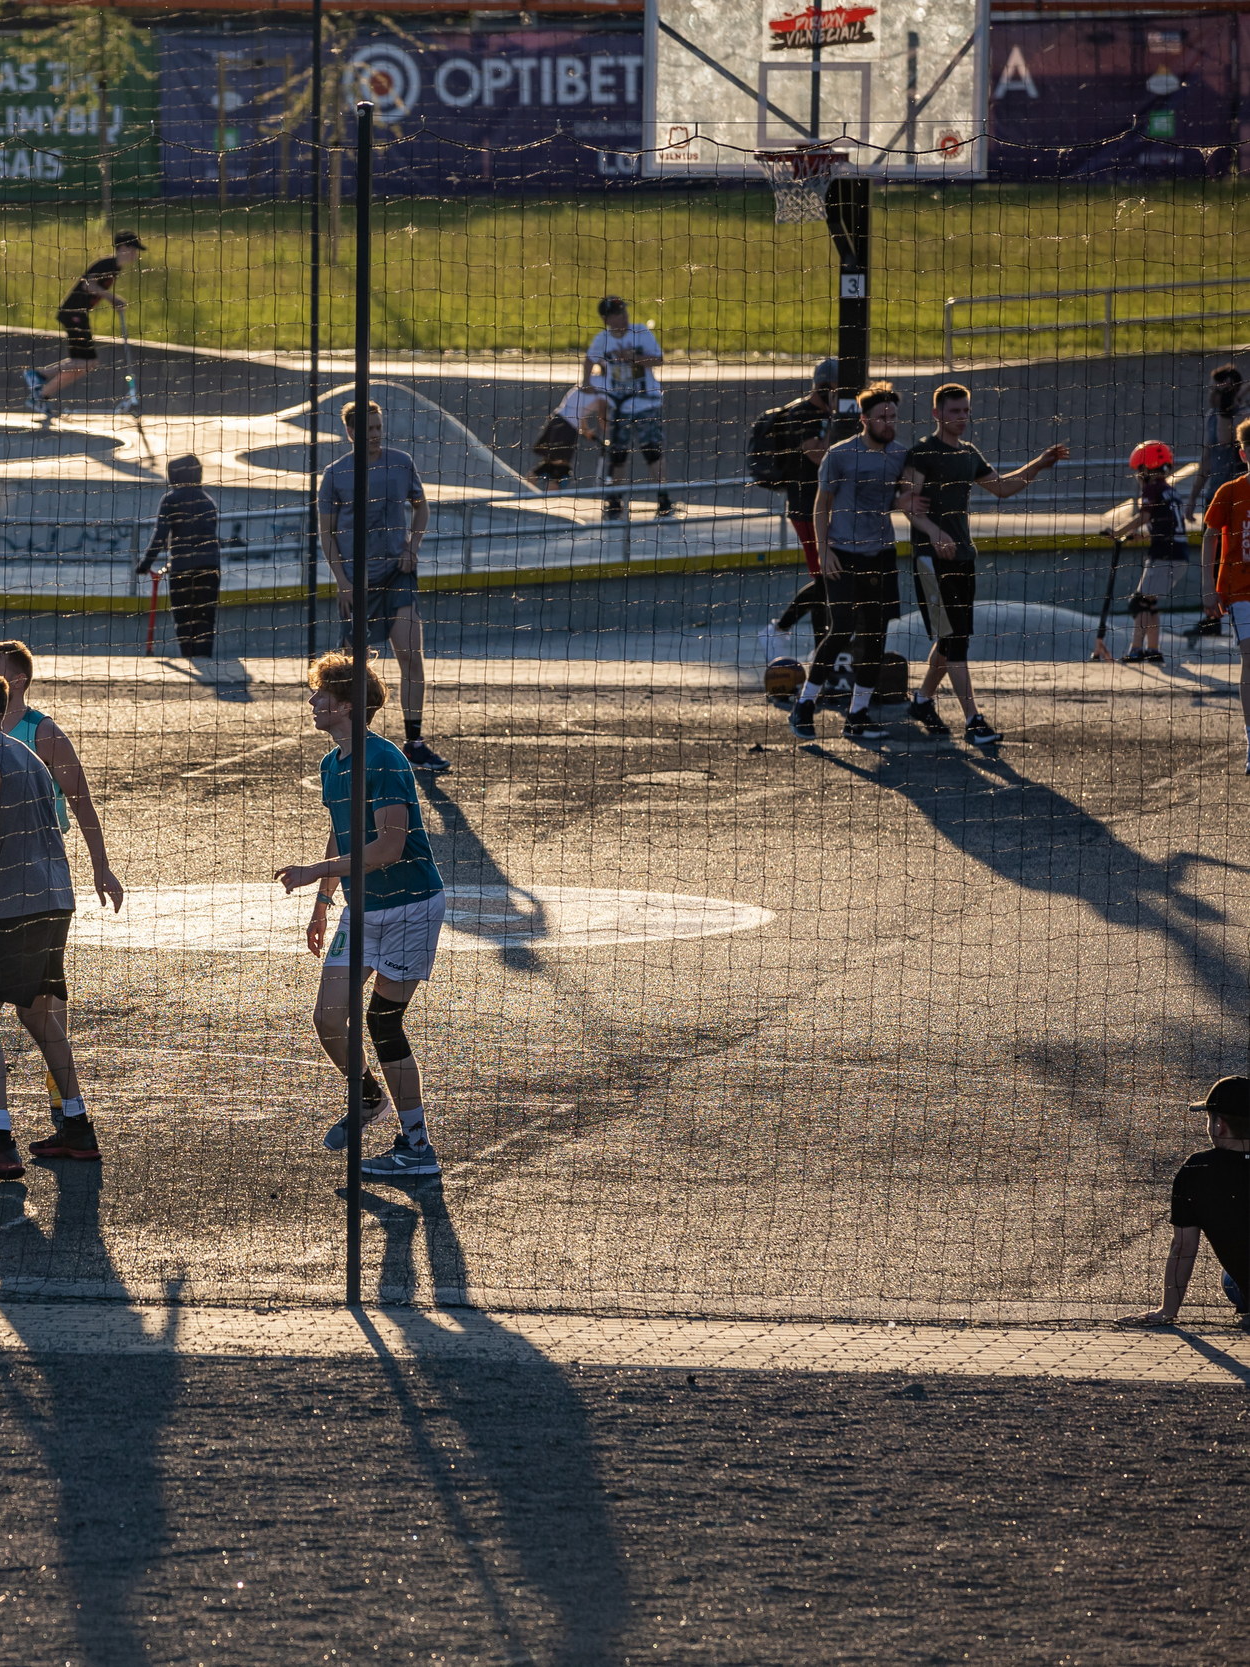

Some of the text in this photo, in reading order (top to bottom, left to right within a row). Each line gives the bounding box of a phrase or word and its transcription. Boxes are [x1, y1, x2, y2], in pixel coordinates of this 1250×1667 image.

[435, 55, 643, 106] OPTIBET
[658, 153, 699, 161] VILNIUS
[847, 278, 858, 294] 3
[384, 960, 409, 972] LEGEA
